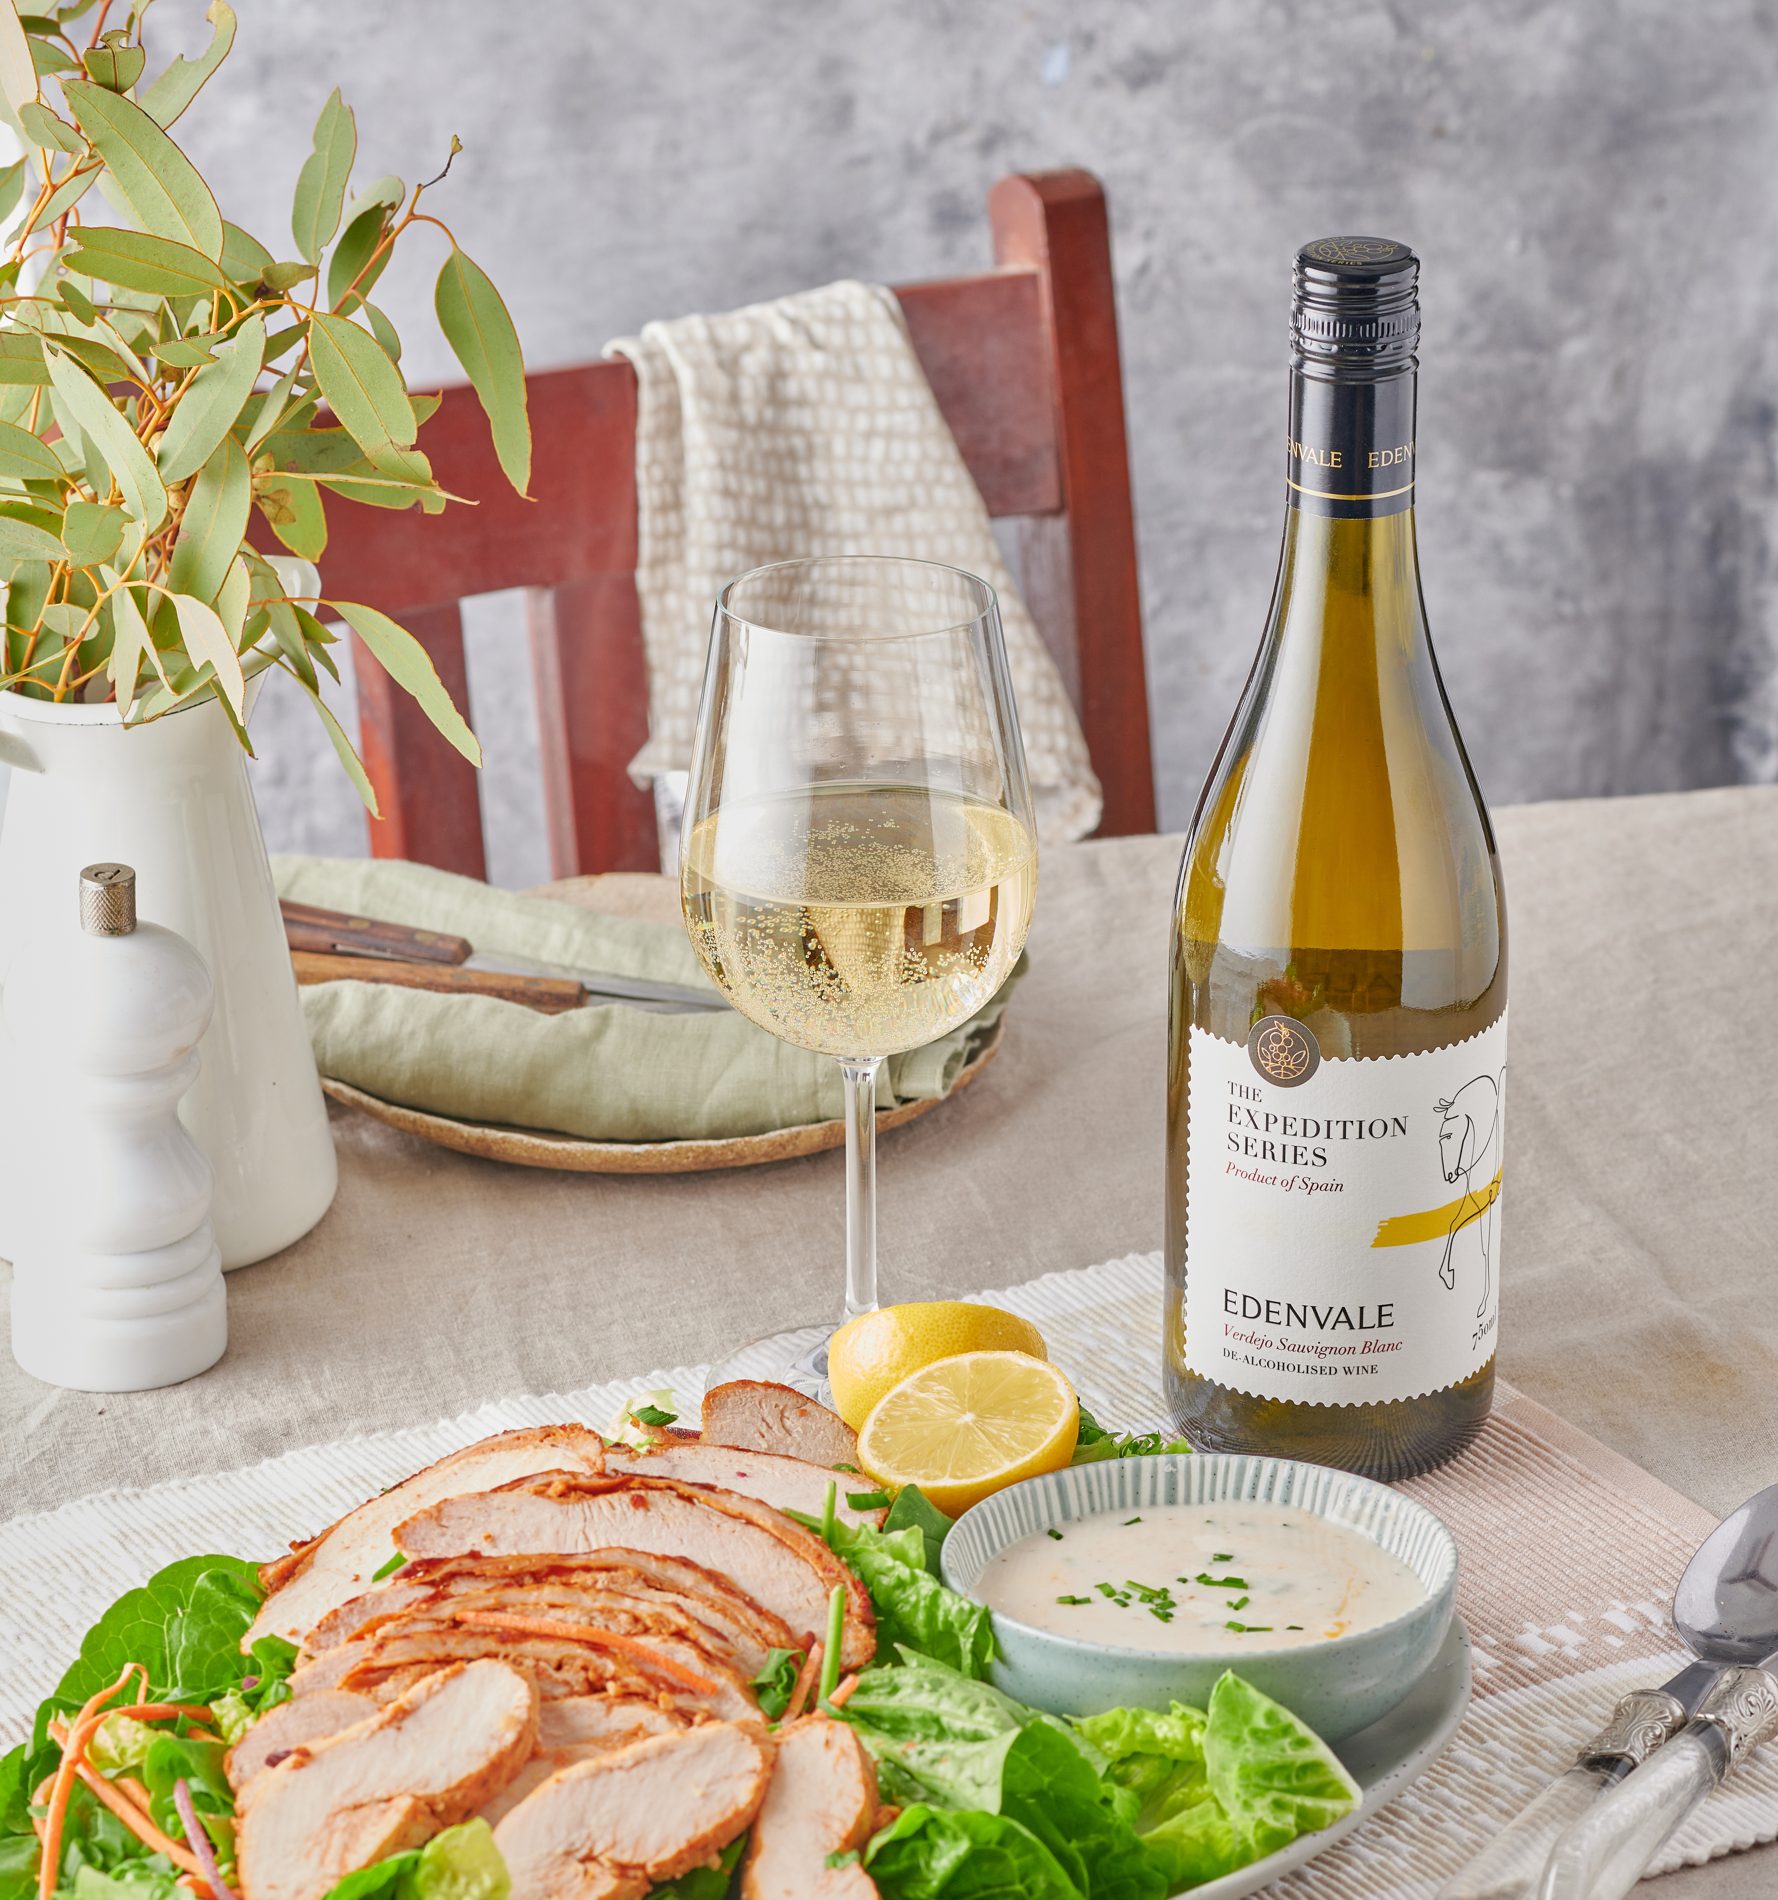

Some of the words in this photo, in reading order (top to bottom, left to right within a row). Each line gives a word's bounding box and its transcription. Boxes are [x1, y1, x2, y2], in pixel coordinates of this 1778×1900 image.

[1227, 1080, 1262, 1103] THE
[1228, 1103, 1409, 1141] EXPEDITION
[1227, 1132, 1328, 1168] SERIES
[1225, 1161, 1278, 1187] Product
[1280, 1175, 1299, 1192] of
[1298, 1175, 1345, 1194] Spain
[1223, 1288, 1395, 1331] EDENVALE
[1472, 1304, 1497, 1351] 750ml
[1223, 1323, 1273, 1349] Verdejo
[1275, 1336, 1357, 1360] Sauvignon
[1360, 1339, 1403, 1356] Blanc
[1223, 1347, 1338, 1376] DE-ALCOHOLISED
[1342, 1363, 1379, 1376] WINE
